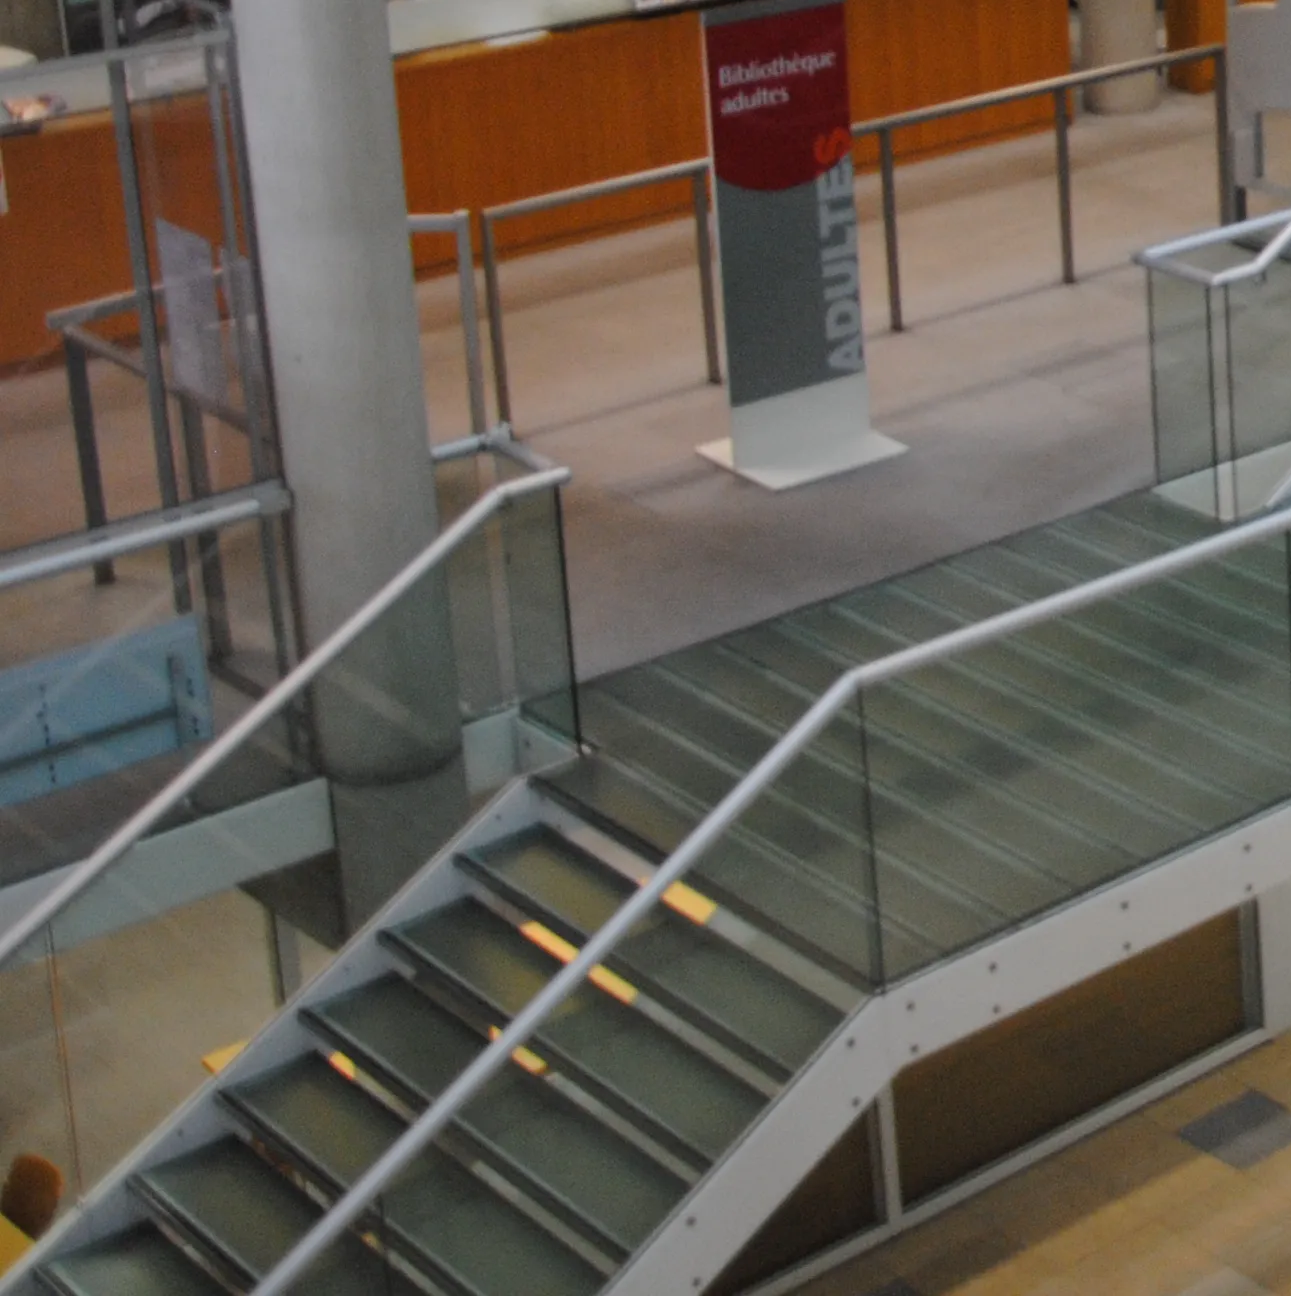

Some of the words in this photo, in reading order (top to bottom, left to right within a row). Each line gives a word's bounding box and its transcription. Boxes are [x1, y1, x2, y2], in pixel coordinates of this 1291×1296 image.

[718, 51, 836, 88] Bibliothèque
[721, 87, 789, 117] adultes
[814, 125, 866, 371] ADULTES
